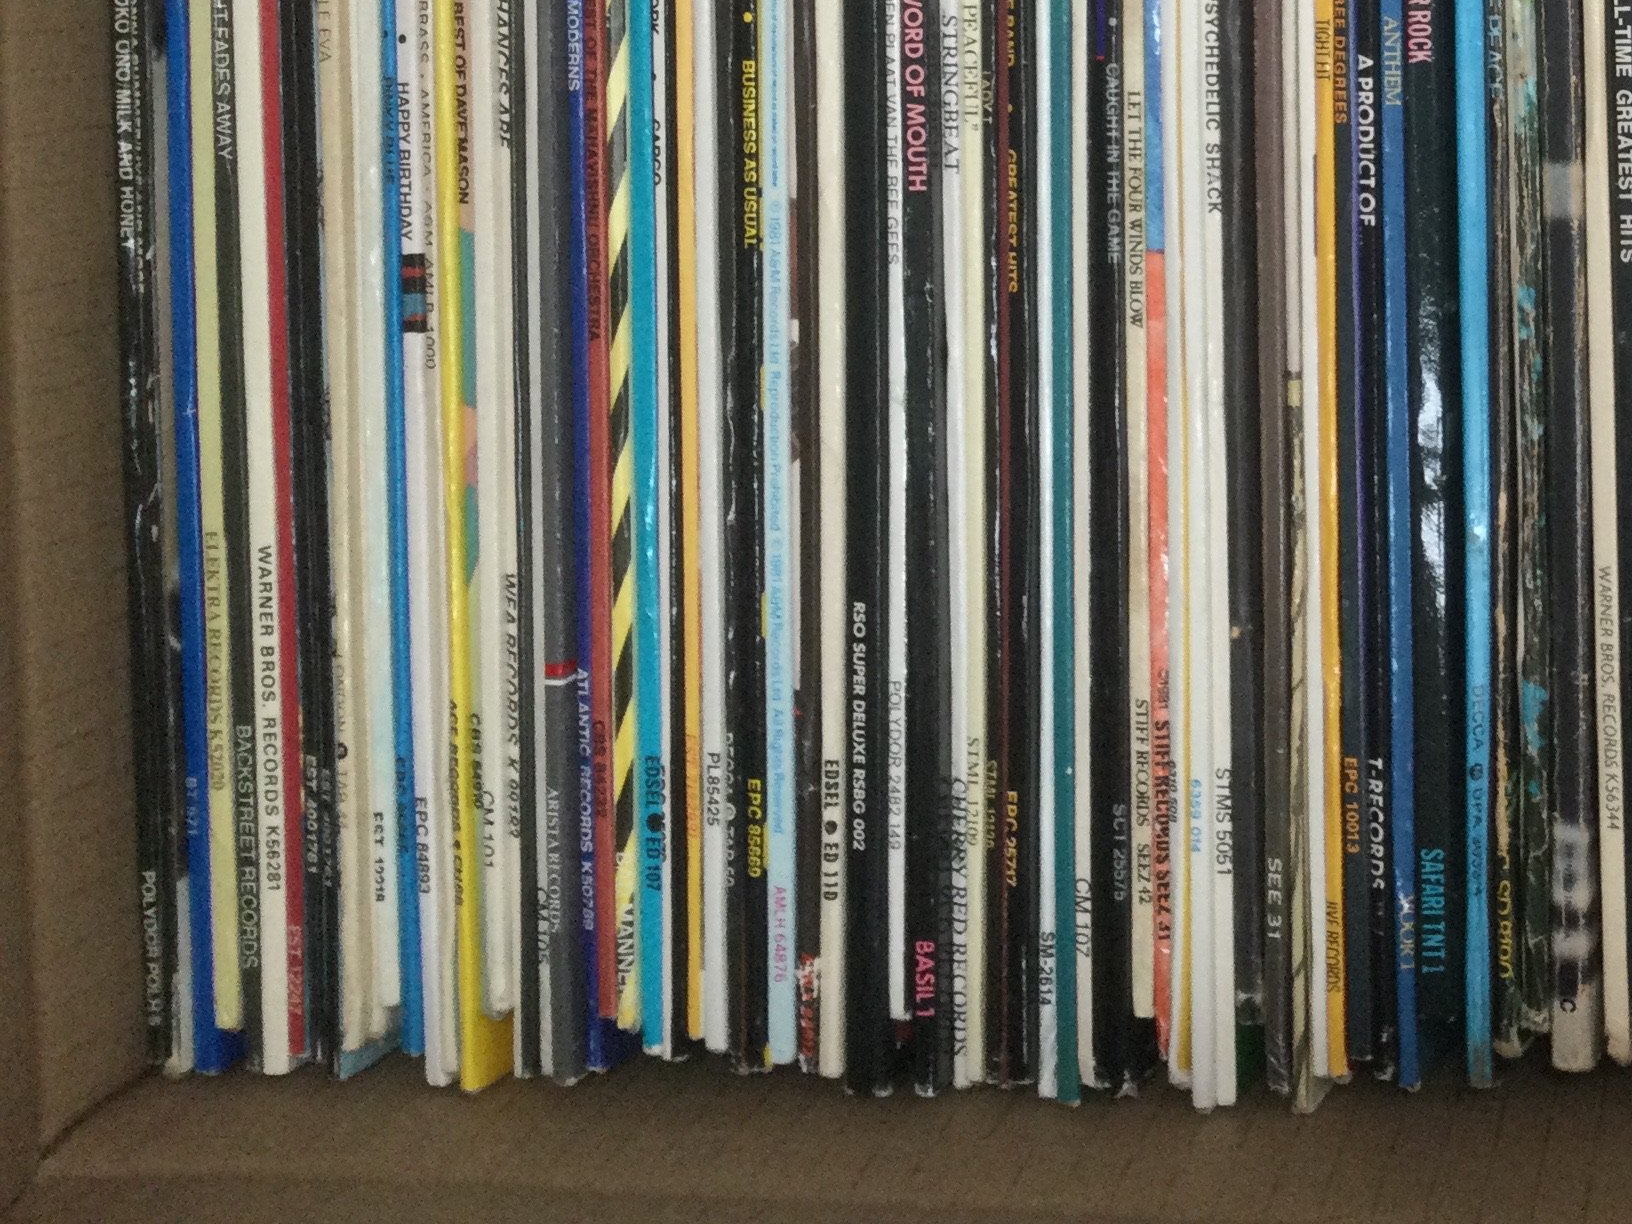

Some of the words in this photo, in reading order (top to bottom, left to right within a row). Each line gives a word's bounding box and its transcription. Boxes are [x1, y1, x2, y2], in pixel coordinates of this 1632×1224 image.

[905, 65, 925, 97] OF
[742, 60, 756, 154] BUSINESS
[1128, 92, 1141, 120] LET
[906, 104, 927, 191] MOUTH
[1128, 127, 1142, 159] THE
[743, 158, 756, 183] AS
[1128, 166, 1142, 212] FOUR
[744, 188, 757, 248] USUAL
[1129, 219, 1142, 274] WINDS
[1129, 281, 1143, 328] BLOW
[257, 546, 275, 636] WARNER
[853, 602, 865, 638] RSO
[260, 646, 276, 707] BROS.
[853, 643, 865, 695] SUPER
[853, 701, 865, 763] DELUXE
[262, 719, 279, 816] RECORDS
[707, 753, 721, 826] PL85425
[264, 826, 280, 890] K56281
[853, 819, 865, 850] 002
[1268, 858, 1282, 905] SEE
[1421, 849, 1445, 914] SAFARI
[1268, 917, 1282, 939] 31
[1422, 921, 1445, 957] TNT
[1423, 965, 1446, 973] 1
